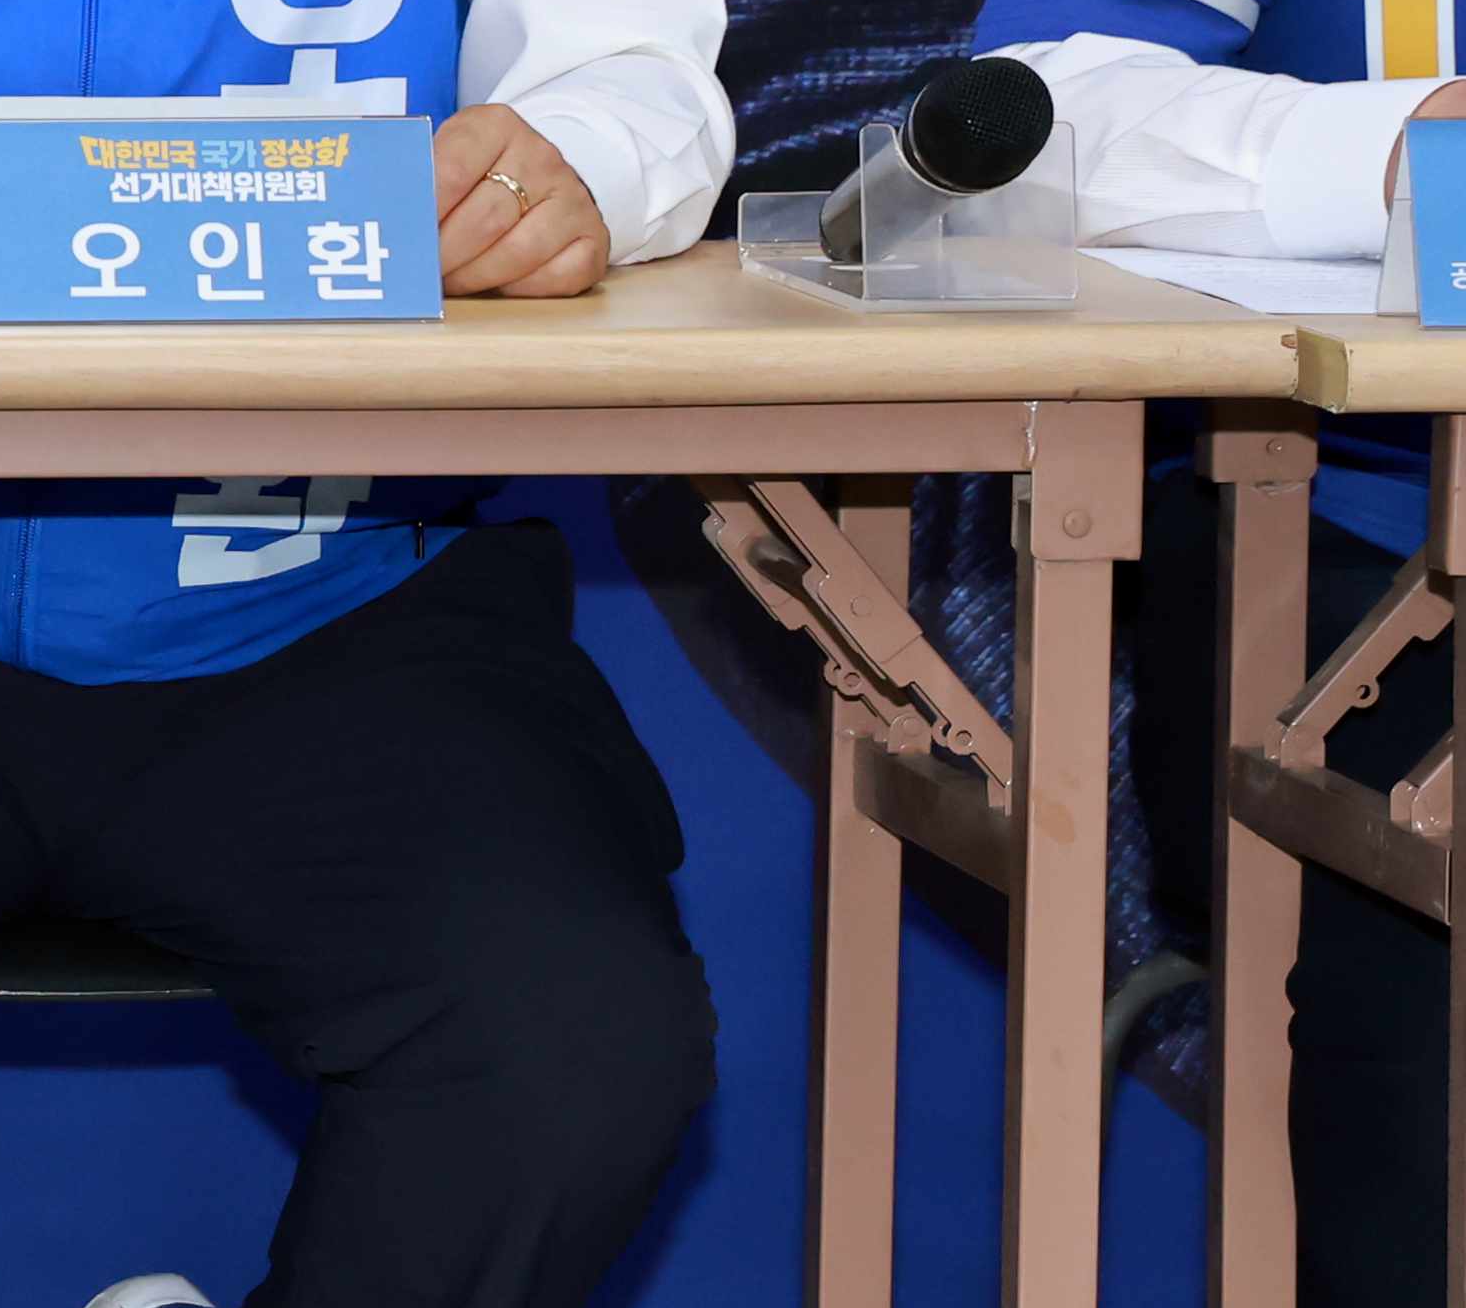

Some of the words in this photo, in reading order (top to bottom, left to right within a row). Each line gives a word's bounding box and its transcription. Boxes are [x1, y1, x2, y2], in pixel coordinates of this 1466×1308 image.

[78, 134, 196, 169] 대한민국
[201, 138, 257, 168] 국가
[260, 133, 351, 169] 정상화
[109, 171, 327, 203] 선거대책위원회
